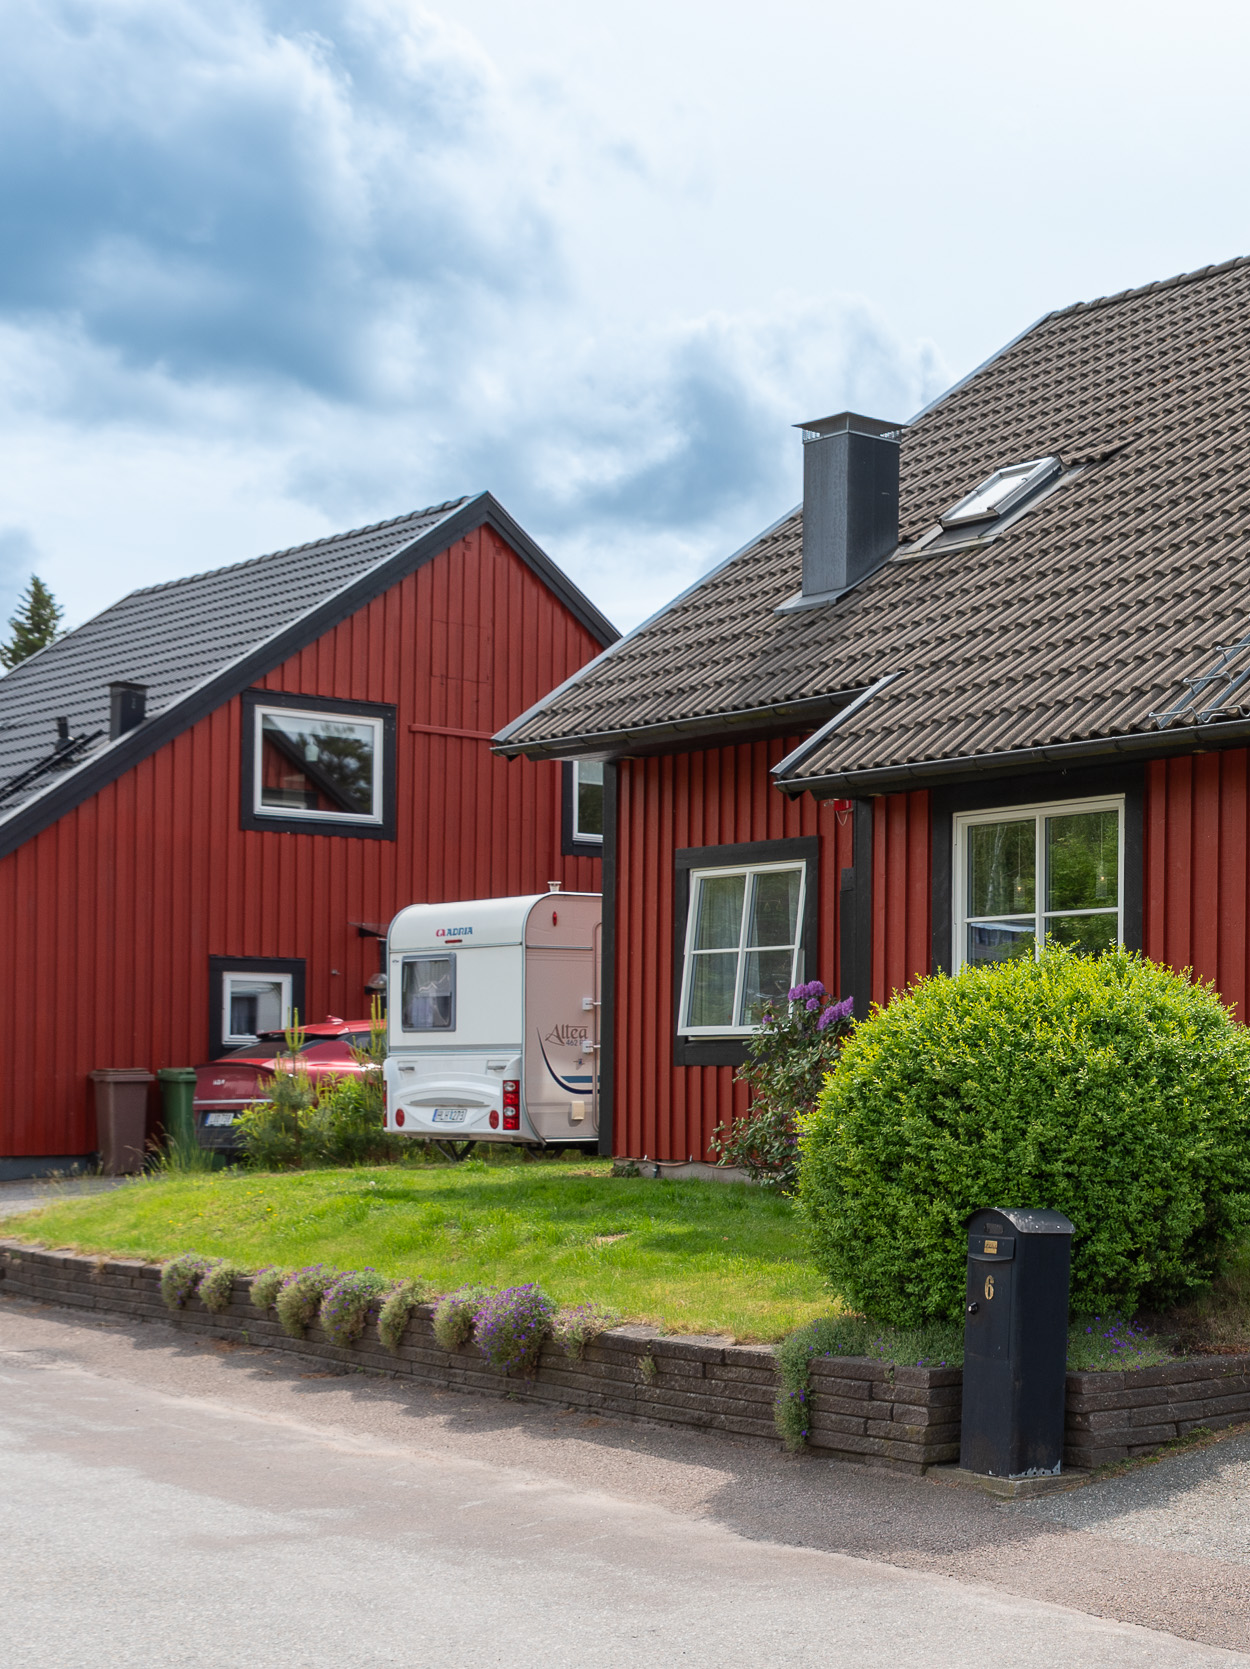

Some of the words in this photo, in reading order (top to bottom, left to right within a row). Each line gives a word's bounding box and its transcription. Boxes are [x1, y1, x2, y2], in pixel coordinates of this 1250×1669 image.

[446, 926, 473, 937] ADRIA
[545, 1023, 588, 1046] Altea
[566, 1039, 578, 1047] 462
[984, 1274, 994, 1300] 6
